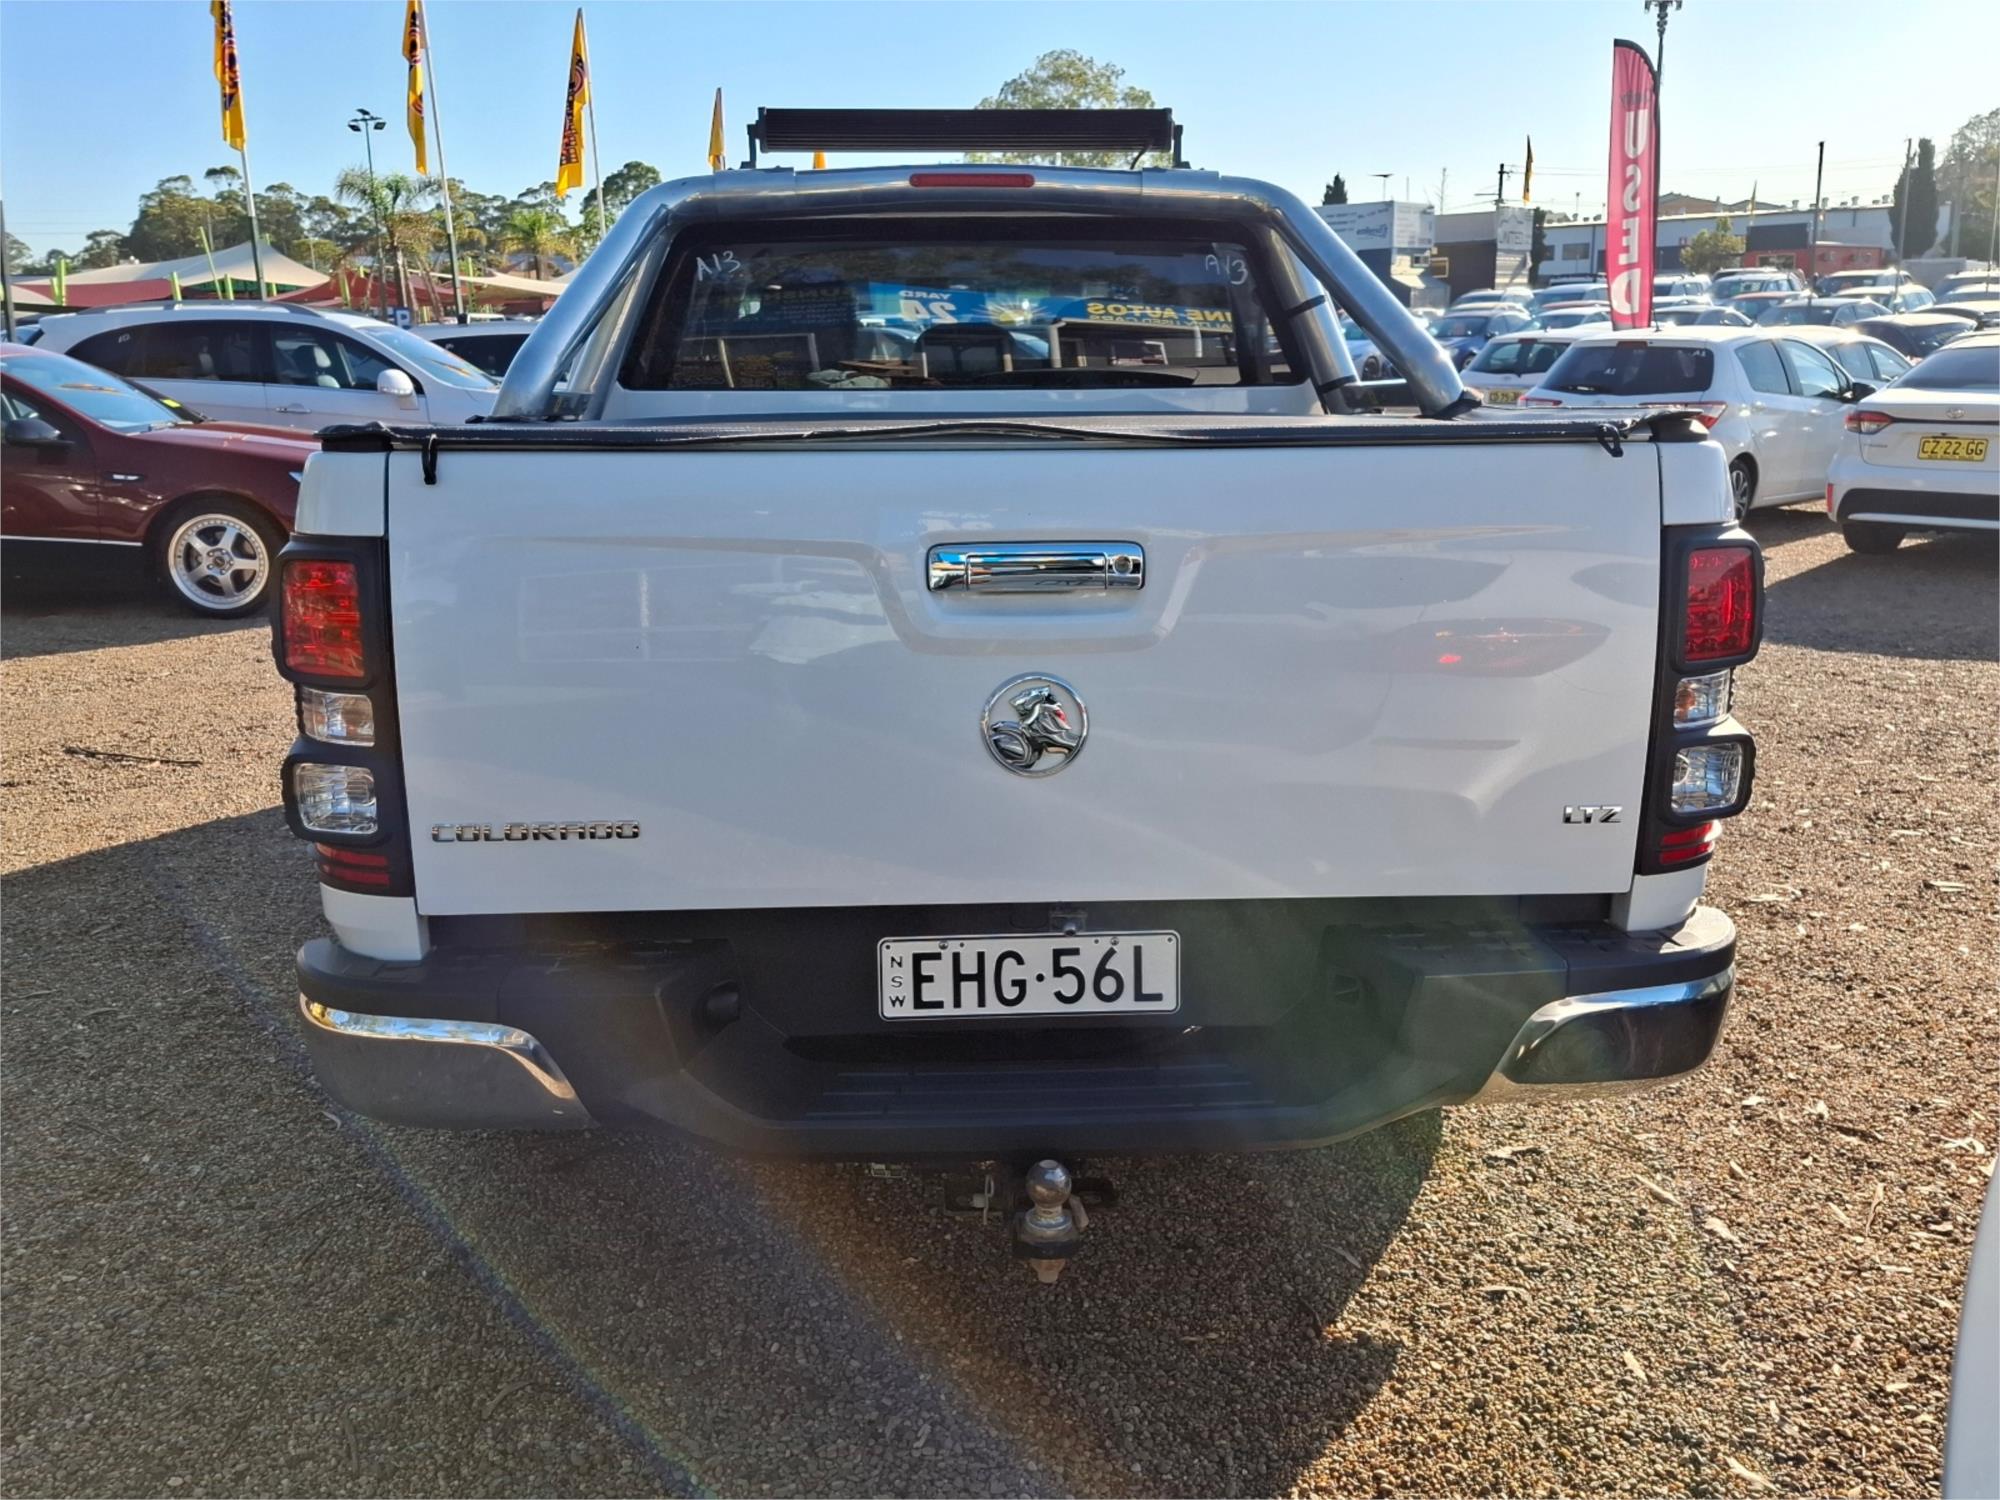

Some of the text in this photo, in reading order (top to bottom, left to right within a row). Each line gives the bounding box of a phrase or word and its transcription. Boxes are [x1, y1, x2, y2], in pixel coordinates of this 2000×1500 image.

[1205, 254, 1249, 285] A13
[1562, 805, 1623, 824] LTZ
[431, 820, 640, 842] COLORADO
